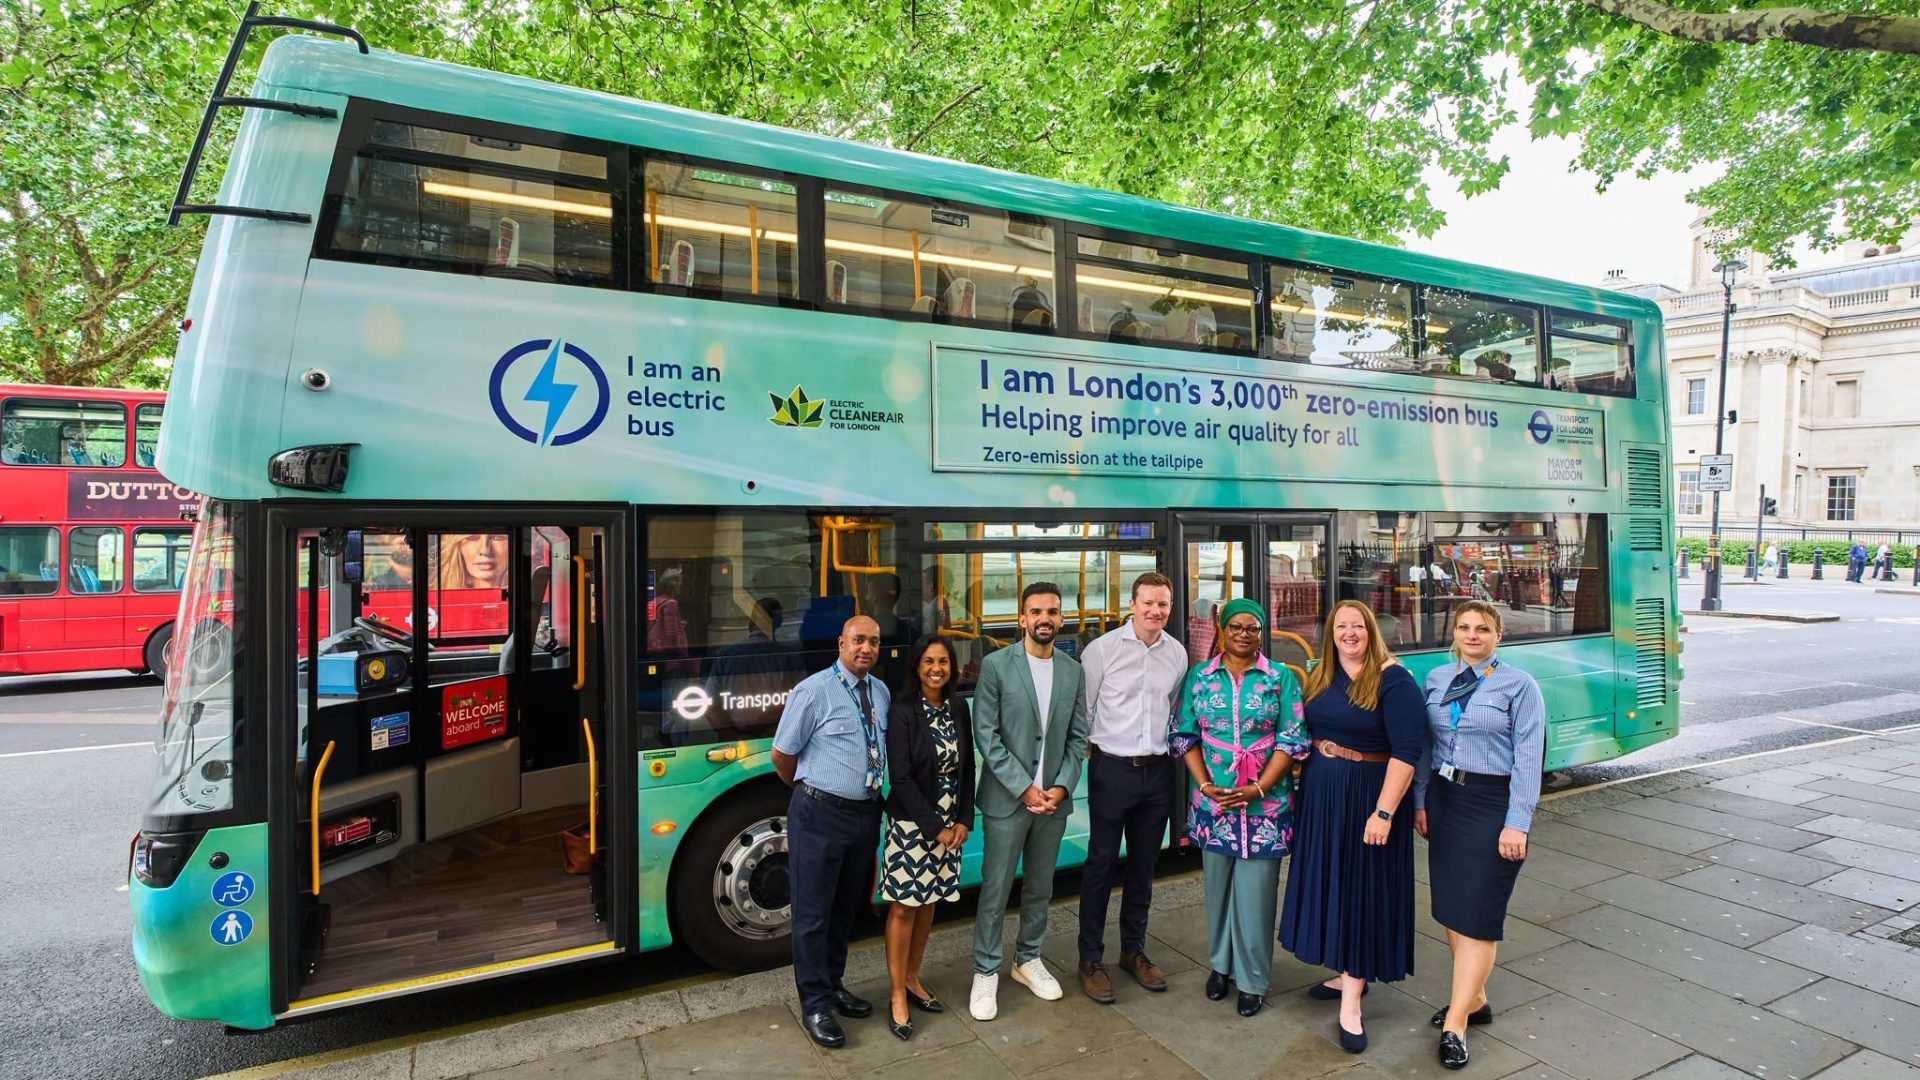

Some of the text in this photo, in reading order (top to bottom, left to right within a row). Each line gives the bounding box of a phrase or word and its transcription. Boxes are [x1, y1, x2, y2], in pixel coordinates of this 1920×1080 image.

[627, 356, 721, 382] I am an
[627, 386, 725, 411] electric
[829, 400, 864, 409] ELECTRIC
[981, 359, 989, 390] I
[1003, 369, 1054, 394] am
[1068, 367, 1201, 405] London's
[1306, 393, 1459, 425] zero-emission
[1465, 403, 1499, 428] bus
[627, 415, 675, 437] bus
[830, 422, 880, 431] FOR LONDON
[982, 404, 1359, 448] Helping improve air quality for all
[1556, 414, 1589, 424] TRANSPORT
[1556, 425, 1594, 435] FOR LONDON
[983, 447, 1203, 471] Zero-emission at the tailpipe
[1547, 458, 1575, 470] MAYOR
[1547, 469, 1583, 481] LONDON
[446, 700, 505, 723] WELCOME
[720, 690, 792, 712] Transpor
[446, 719, 480, 736] aboard
